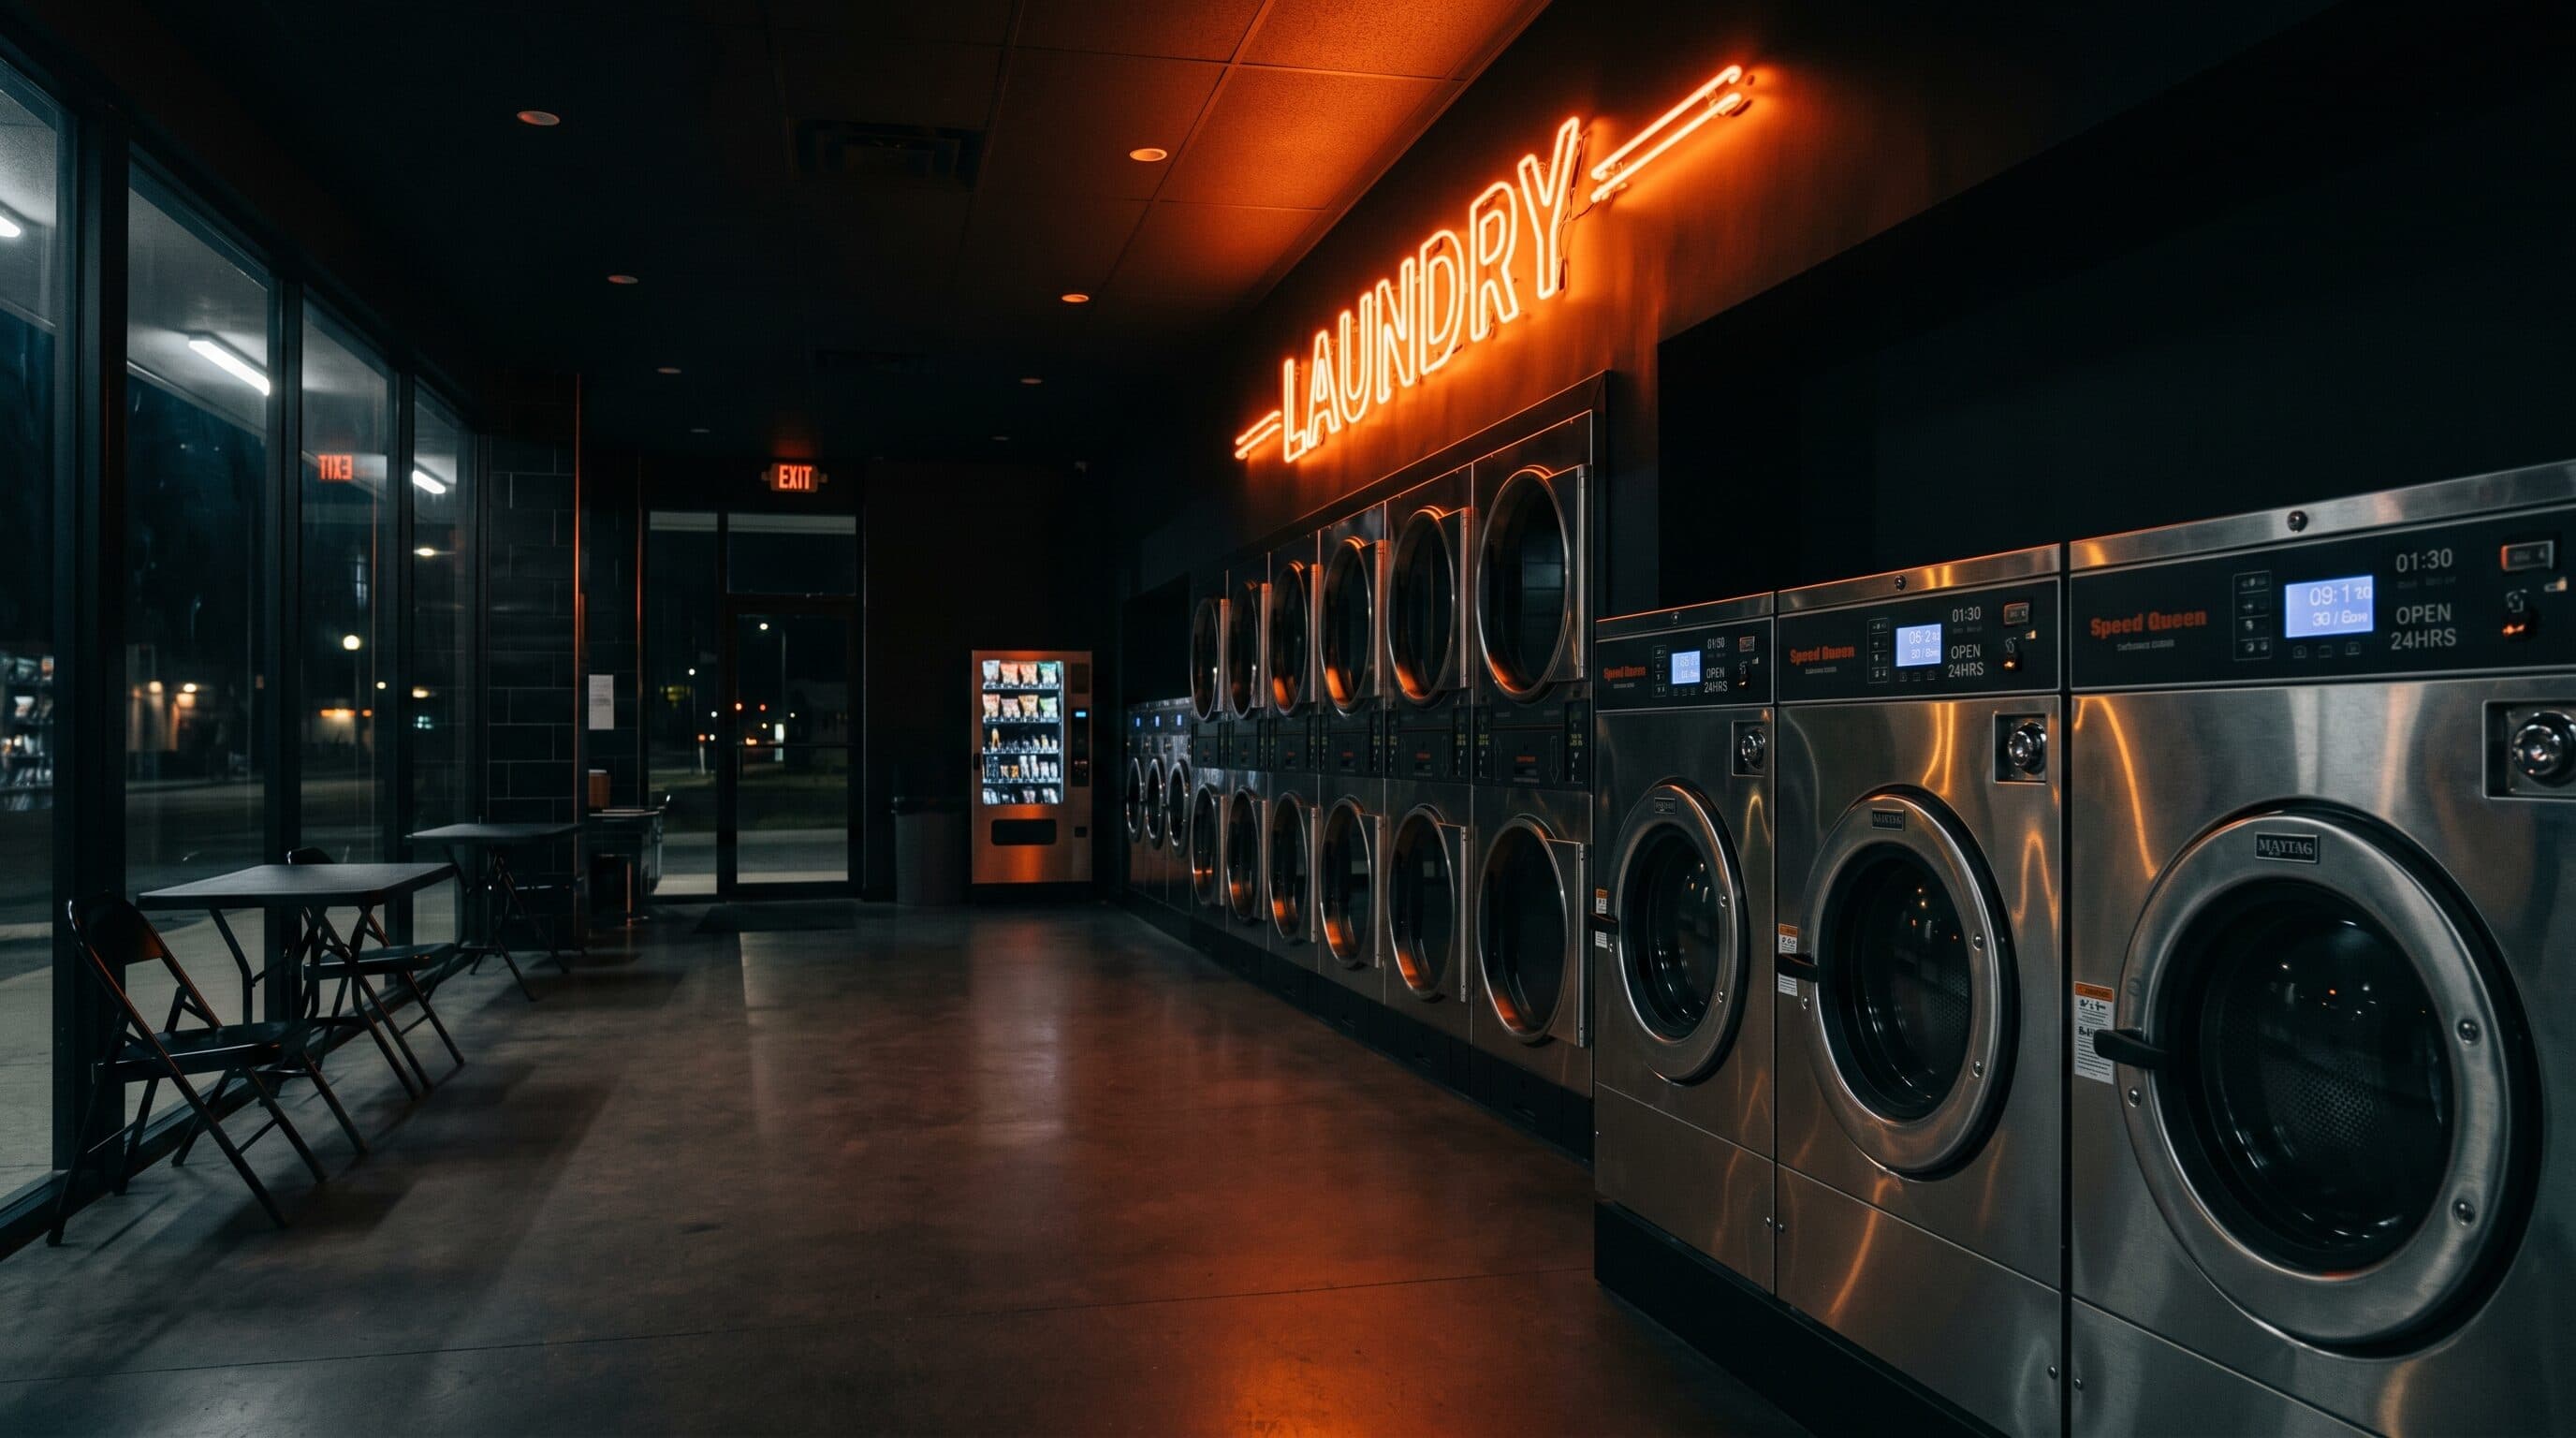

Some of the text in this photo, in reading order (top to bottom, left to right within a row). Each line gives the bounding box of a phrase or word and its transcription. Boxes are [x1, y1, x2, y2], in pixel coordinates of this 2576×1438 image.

[1282, 116, 1581, 463] LAUNDRY
[778, 464, 812, 490] EXIT
[2395, 548, 2453, 574] 01:30
[1952, 606, 1982, 624] 01:30
[2396, 603, 2452, 625] OPEN
[2089, 610, 2208, 640] Speed Queen
[2390, 627, 2457, 651] 24HRS
[1951, 643, 1982, 660] OPEN
[1705, 667, 1726, 680] OPEN
[1948, 661, 1984, 679] 24HRS
[1704, 681, 1729, 694] 24HRS
[2258, 839, 2314, 856] MAYTAG
